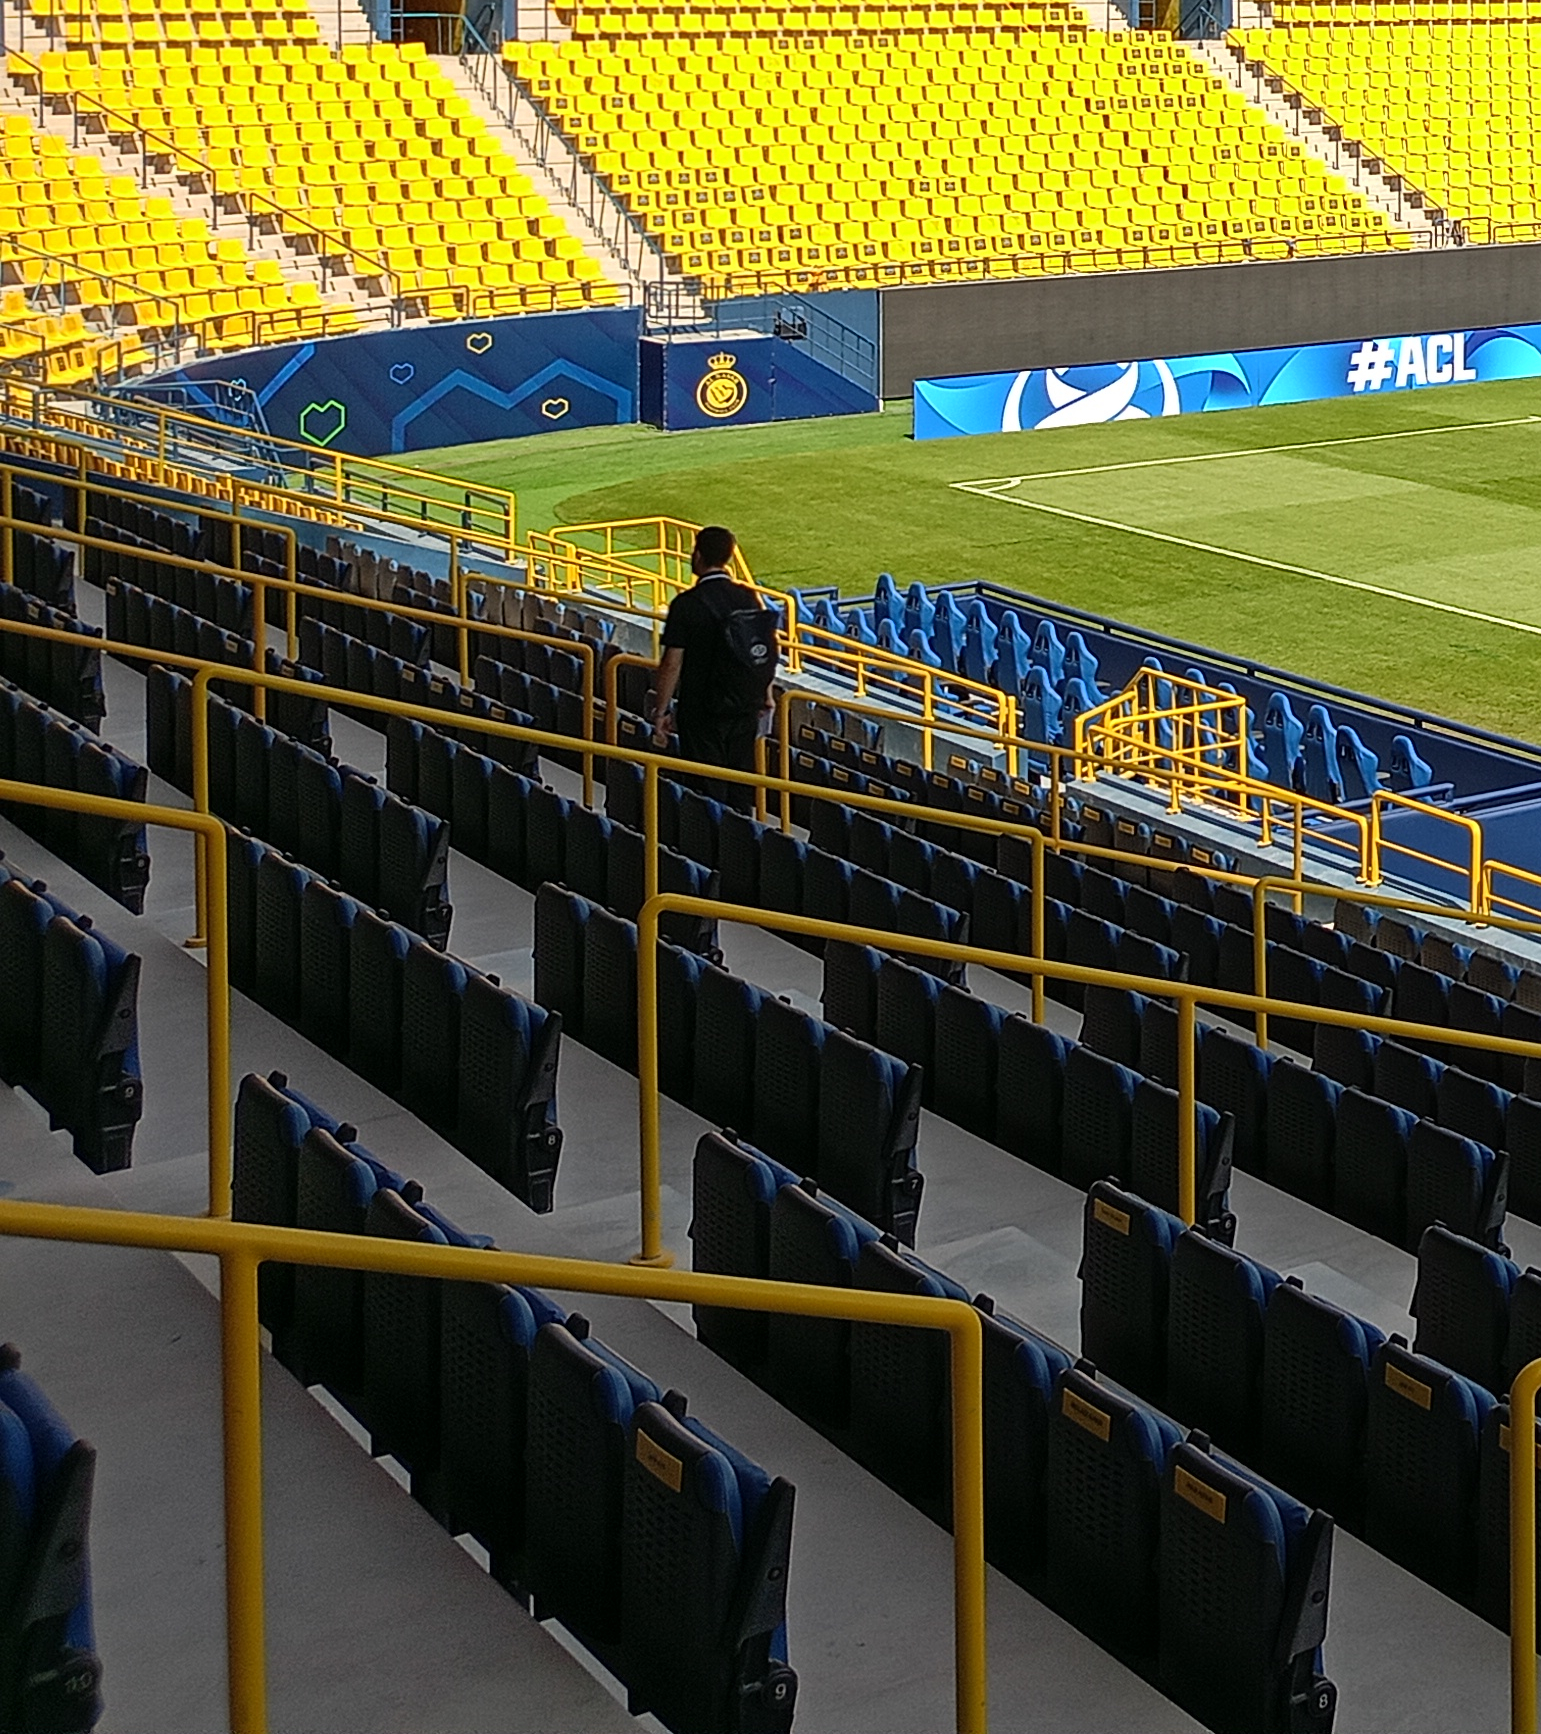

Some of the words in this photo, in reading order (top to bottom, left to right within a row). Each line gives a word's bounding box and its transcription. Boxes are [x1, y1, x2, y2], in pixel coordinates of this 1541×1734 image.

[1347, 332, 1477, 392] #ACL
[547, 1134, 557, 1146] 8
[775, 1683, 787, 1700] 9
[1318, 1693, 1328, 1709] 8
